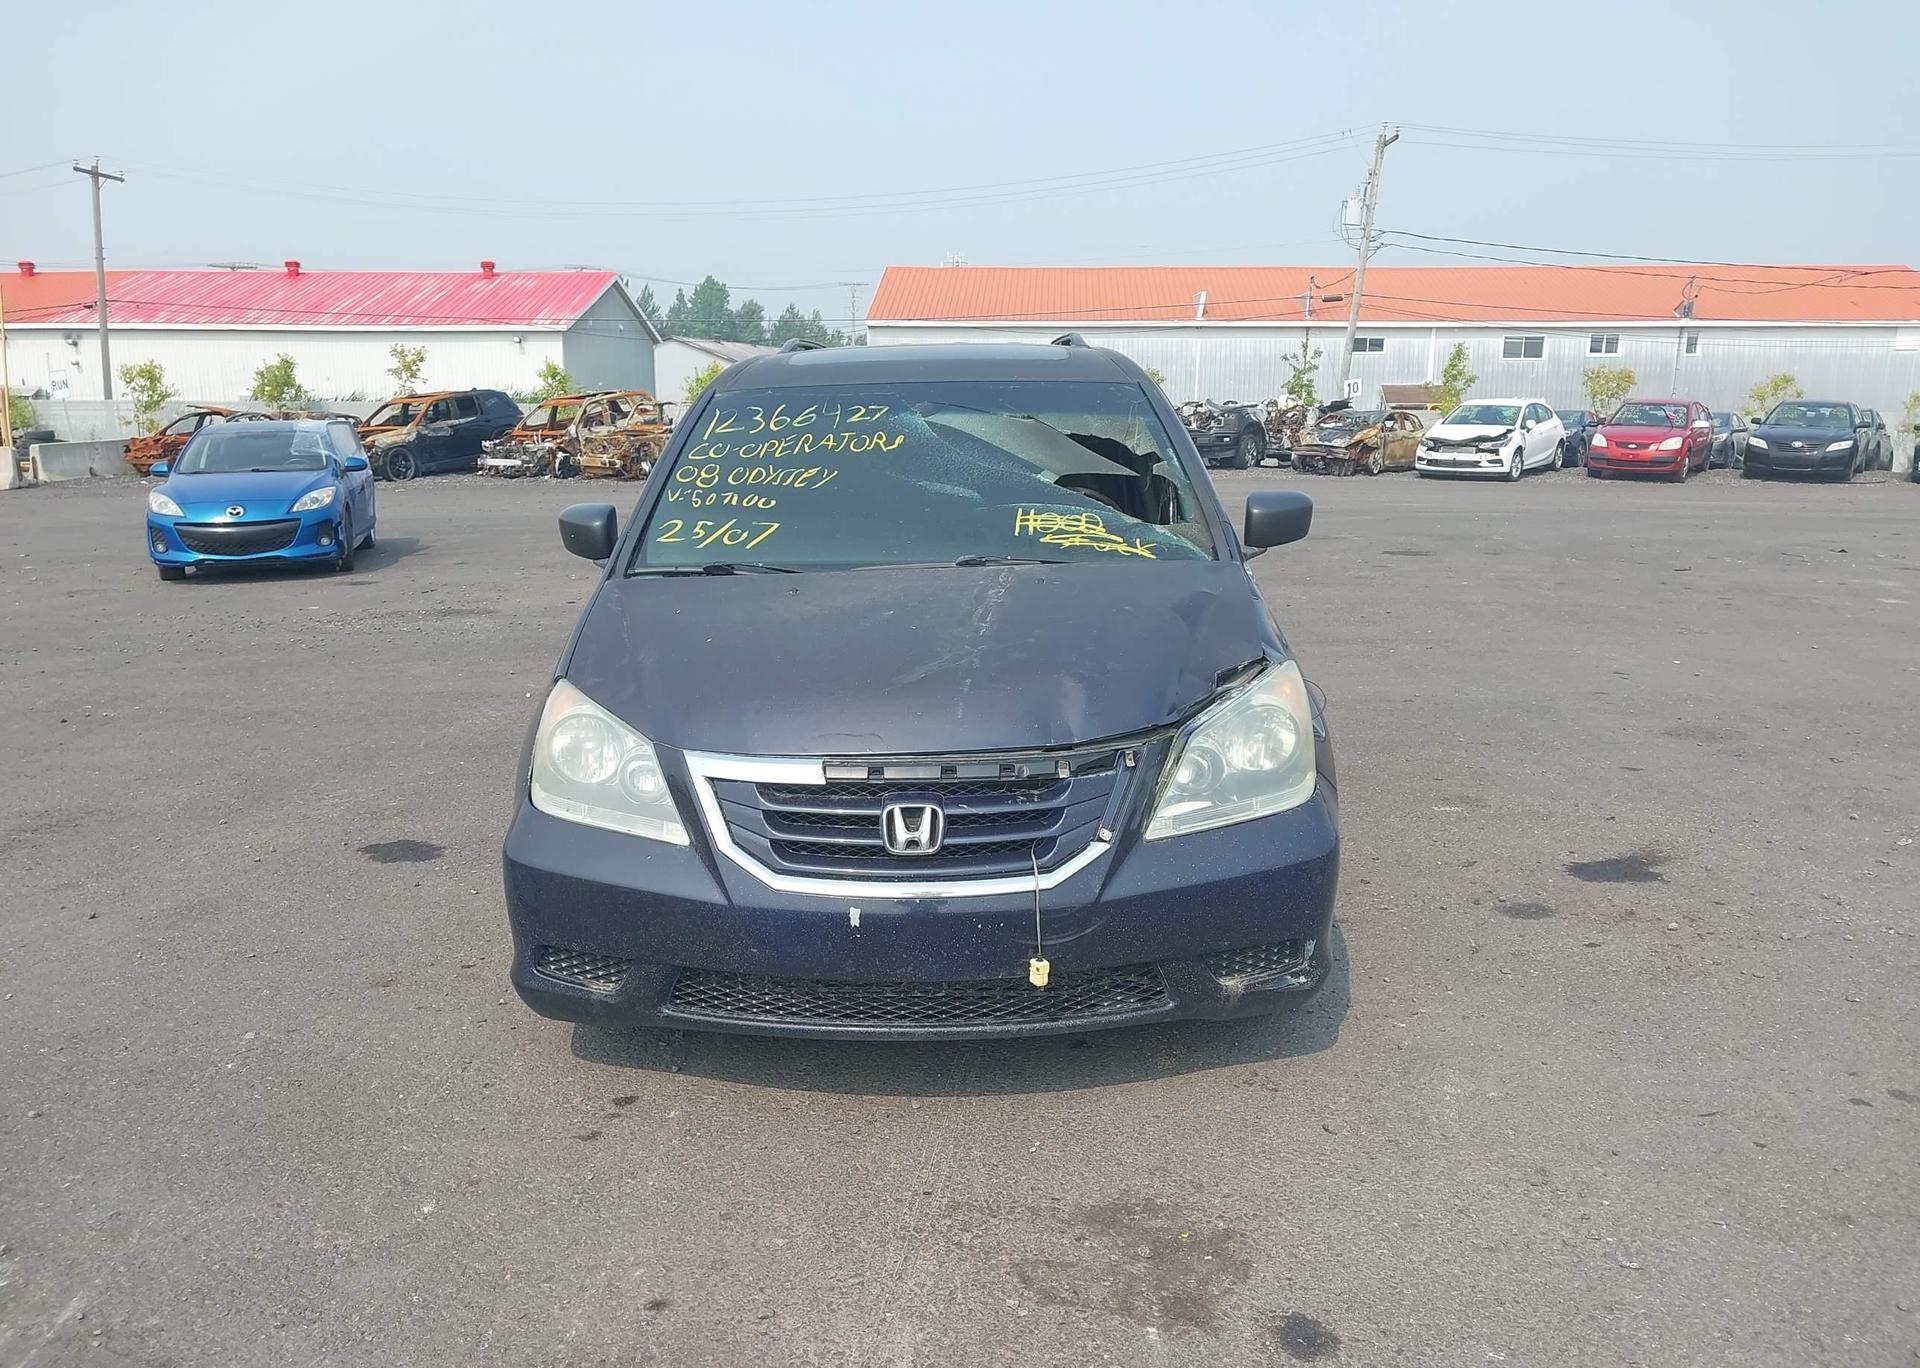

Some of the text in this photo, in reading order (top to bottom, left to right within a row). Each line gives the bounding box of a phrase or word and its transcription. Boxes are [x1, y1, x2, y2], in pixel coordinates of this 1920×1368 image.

[702, 403, 890, 441] 12366427
[675, 463, 839, 490] 08 ODYSSEY
[655, 519, 781, 550] 25/07
